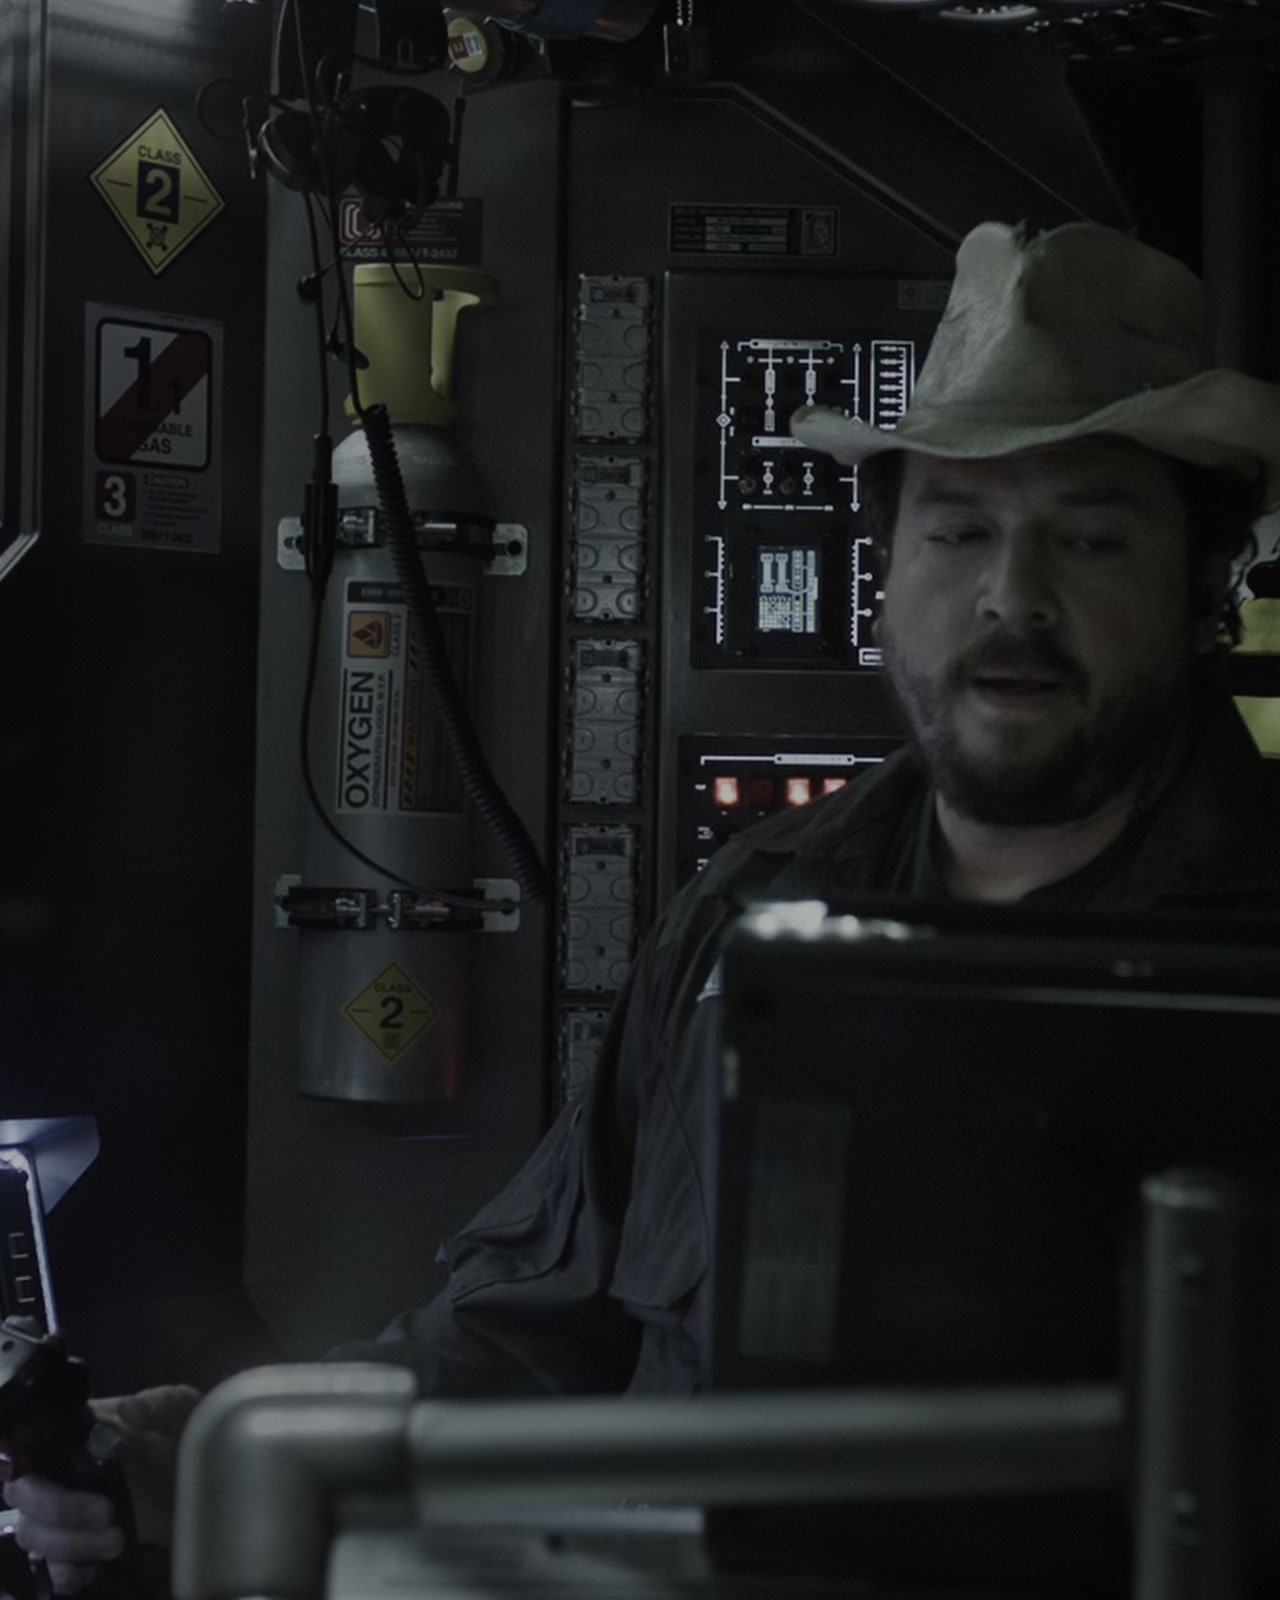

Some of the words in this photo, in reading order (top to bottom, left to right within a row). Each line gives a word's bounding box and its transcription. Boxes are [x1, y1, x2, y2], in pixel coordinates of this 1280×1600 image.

[137, 145, 182, 165] CLASS
[144, 167, 173, 217] 2
[136, 437, 173, 456] GAS
[103, 475, 128, 518] 3
[96, 521, 133, 537] CLASS
[392, 621, 401, 657] CLASS
[406, 680, 417, 746] WARNING
[344, 671, 374, 808] OXYGEN
[372, 737, 383, 807] REFRIGERATED
[374, 983, 411, 993] CLASS
[380, 995, 404, 1029] 2
